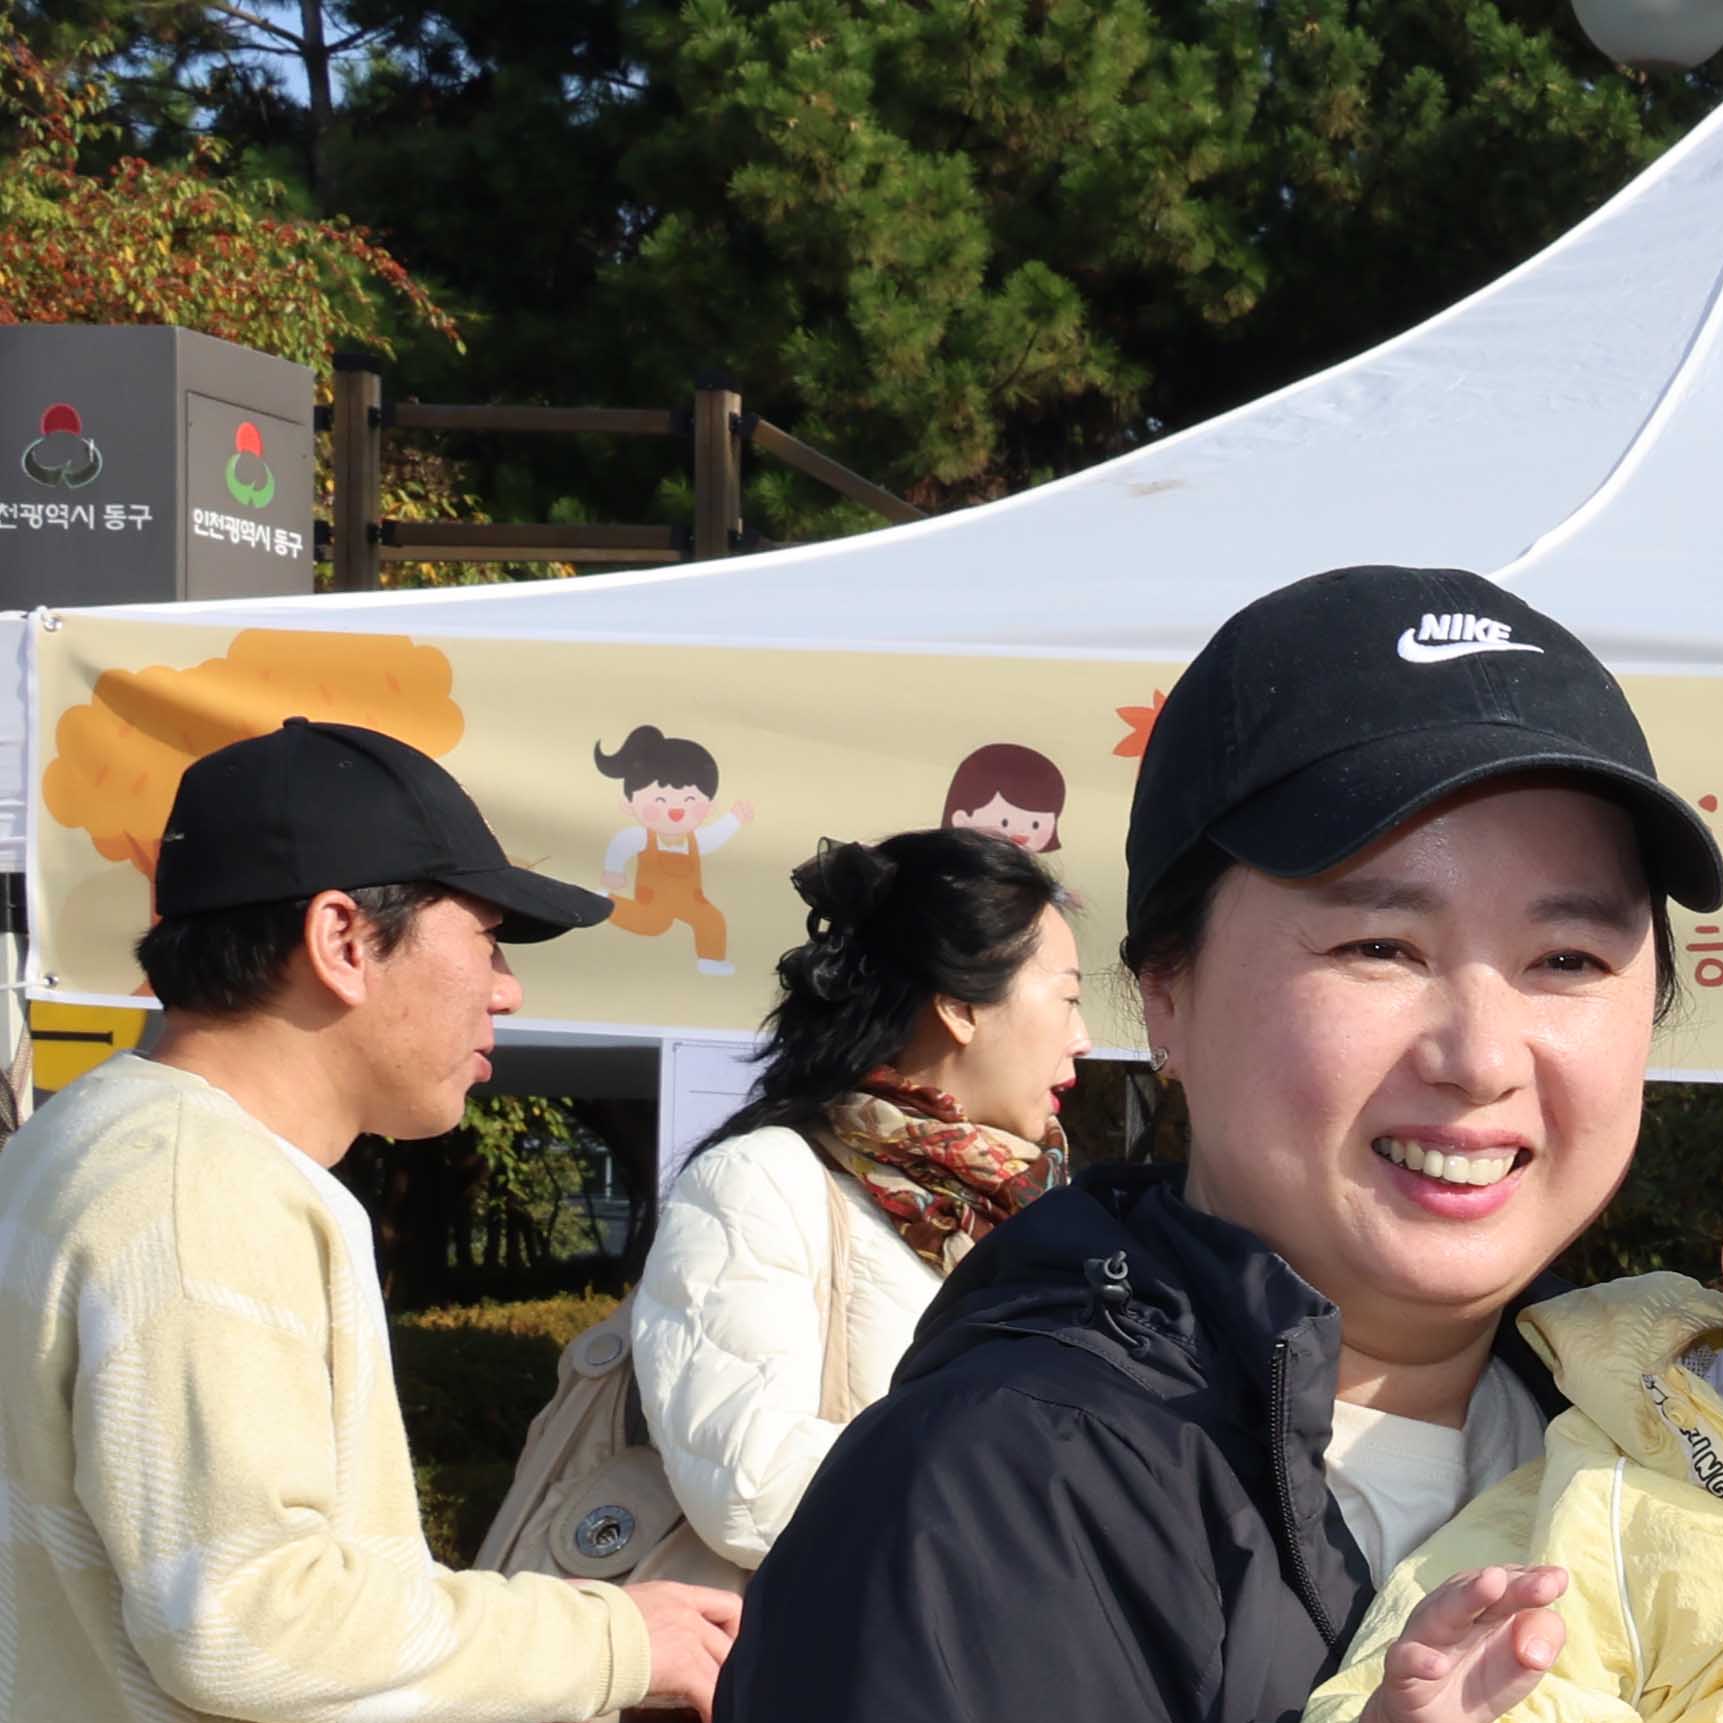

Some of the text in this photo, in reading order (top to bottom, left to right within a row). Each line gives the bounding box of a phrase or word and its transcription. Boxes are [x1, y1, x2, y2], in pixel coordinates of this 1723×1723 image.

[103, 504, 153, 531] 동구
[193, 508, 304, 559] 인천광역시 동구
[1417, 613, 1512, 643] NIKE
